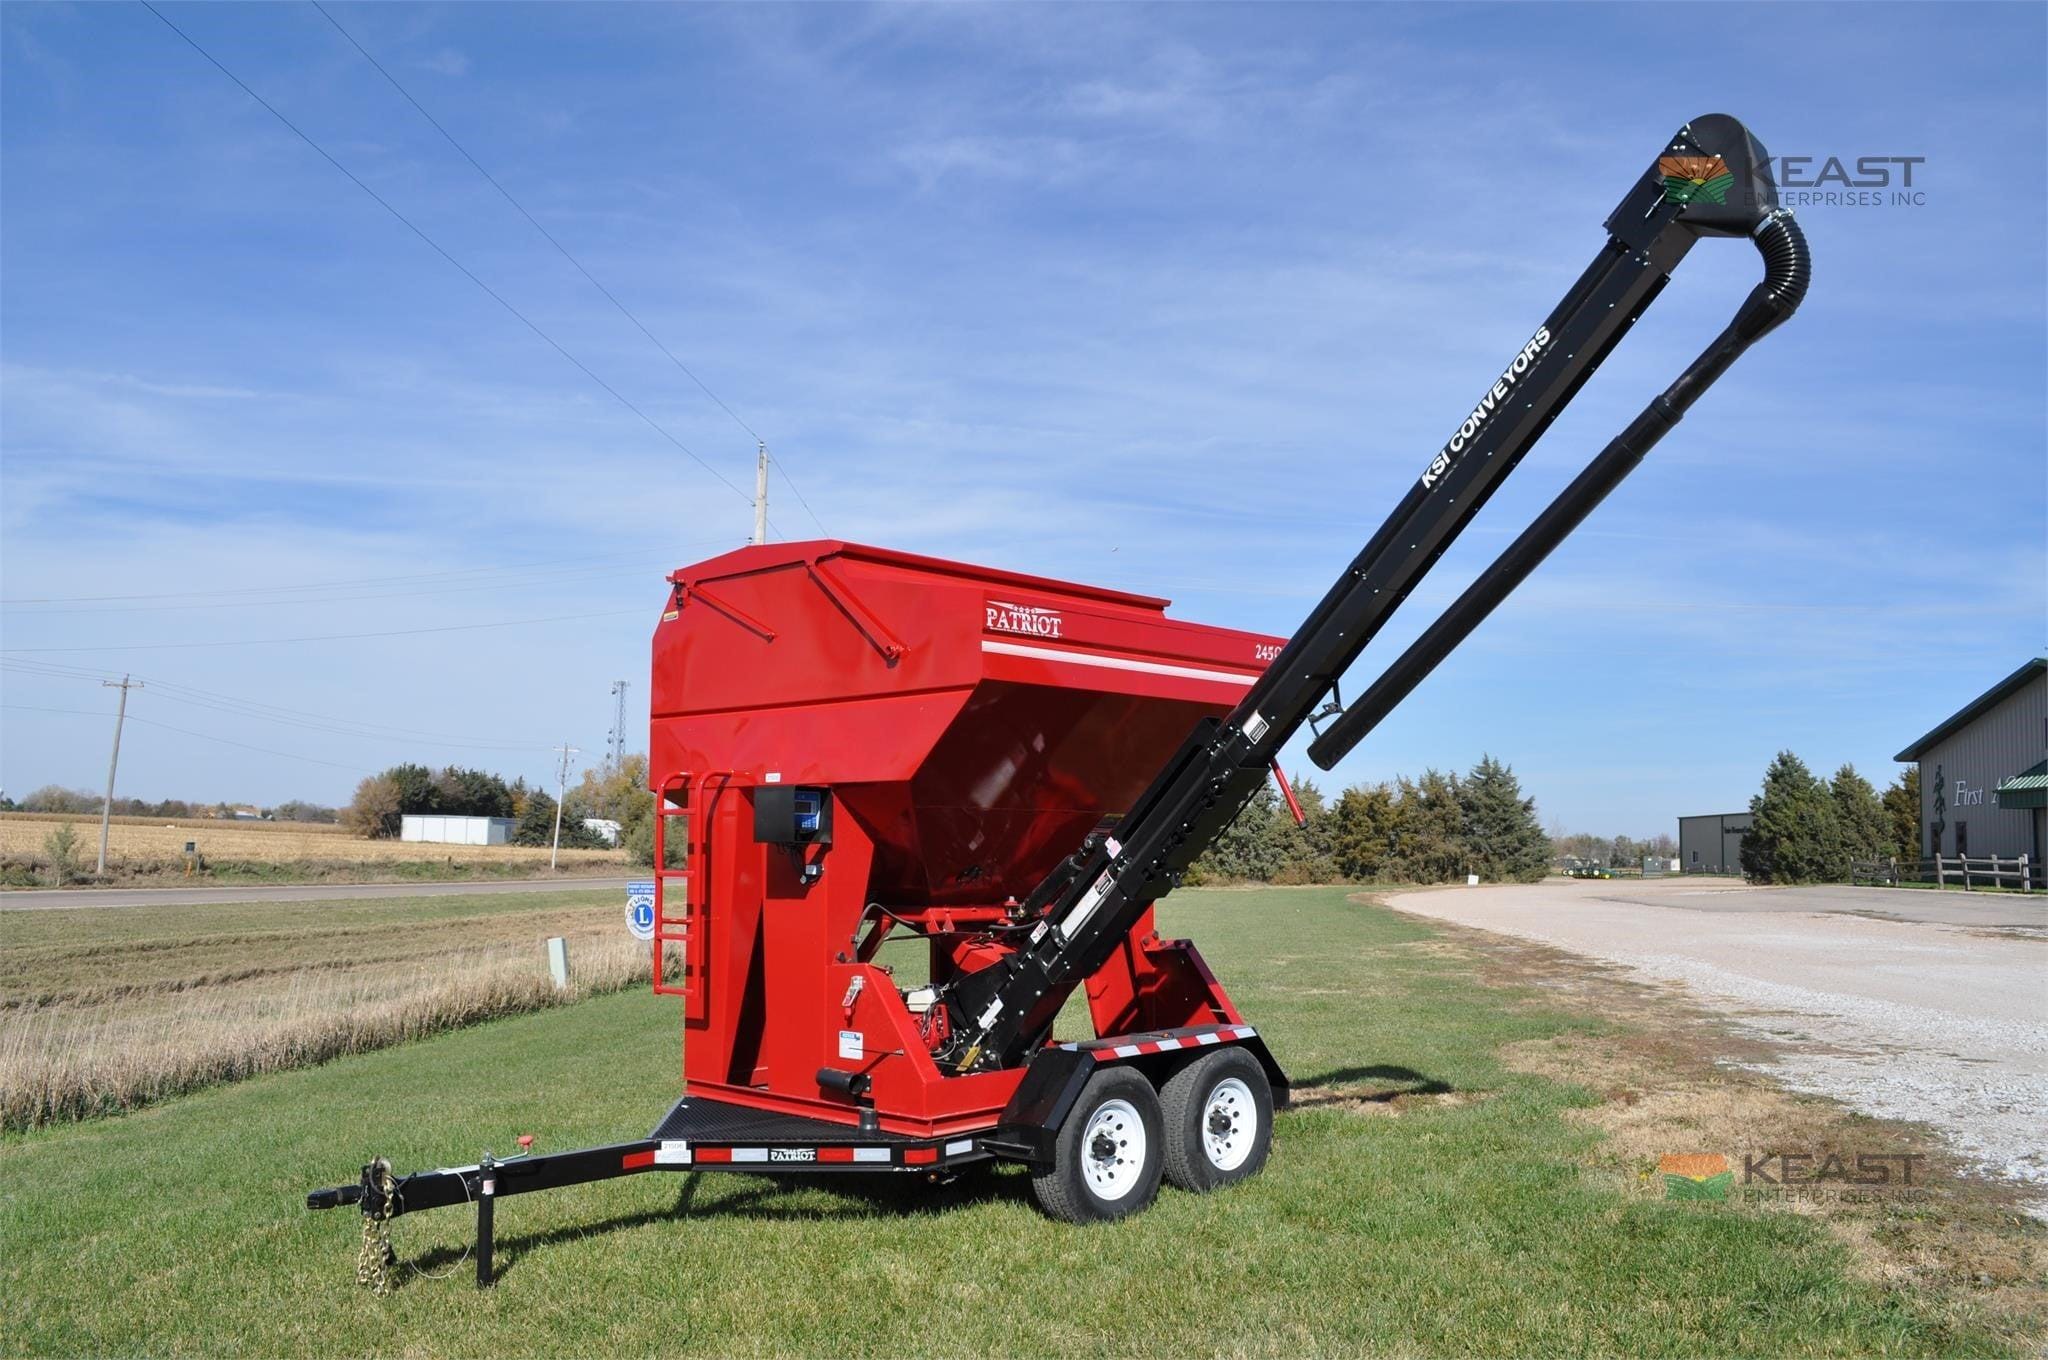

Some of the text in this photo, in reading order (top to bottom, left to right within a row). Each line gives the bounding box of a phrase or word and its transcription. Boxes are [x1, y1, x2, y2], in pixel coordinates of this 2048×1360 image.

[1421, 325, 1551, 489] KSI CONVEYORS
[985, 607, 1062, 636] PATRIOT
[1953, 780, 1984, 806] First
[770, 1151, 816, 1161] PATRIOT
